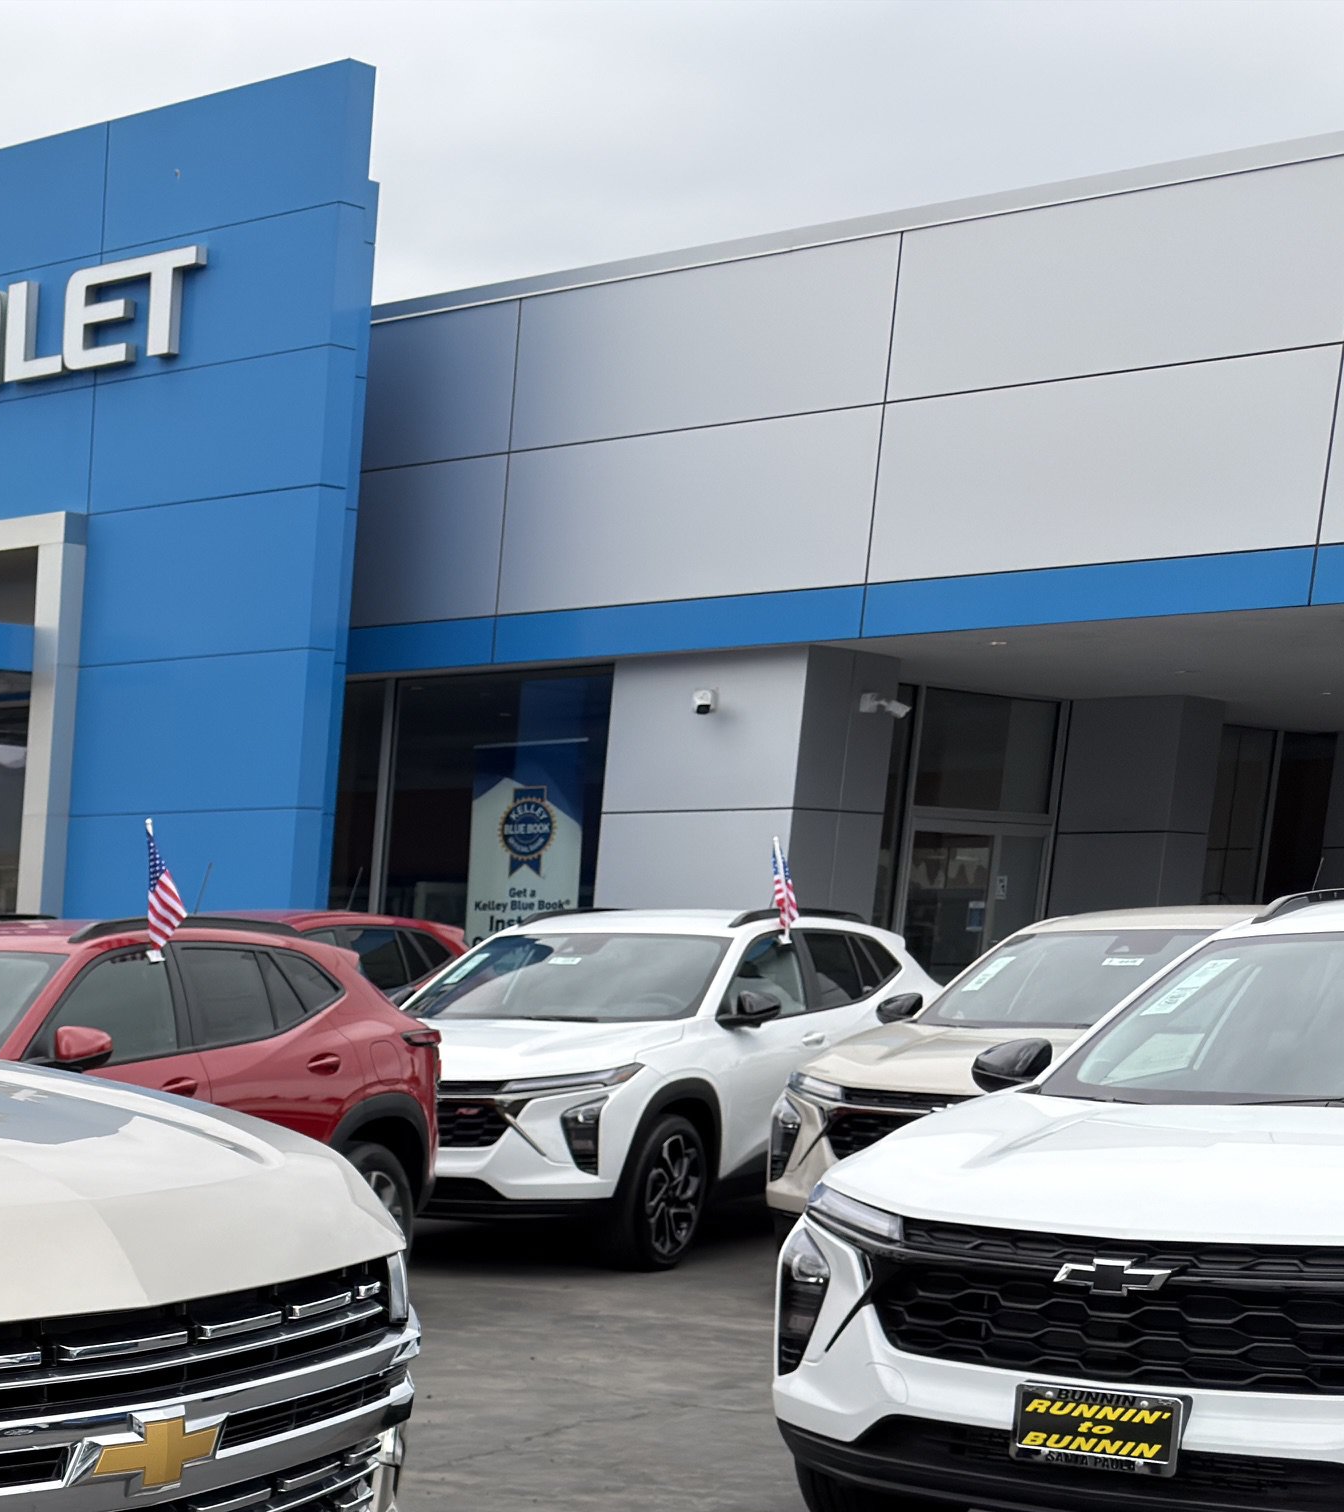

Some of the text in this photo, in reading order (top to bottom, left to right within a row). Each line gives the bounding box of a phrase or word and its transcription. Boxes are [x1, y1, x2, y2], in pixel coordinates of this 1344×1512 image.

[510, 803, 548, 820] KELLEY
[504, 823, 550, 835] BLUE BOOK
[509, 888, 536, 898] Get a
[474, 901, 507, 912] Kelley
[511, 901, 535, 911] Blue
[1057, 1389, 1137, 1407] BUNNIN
[1025, 1399, 1171, 1424] RUNNIN'
[1077, 1421, 1114, 1435] to
[1022, 1431, 1162, 1459] BUNNIN
[1045, 1451, 1089, 1466] SANTA
